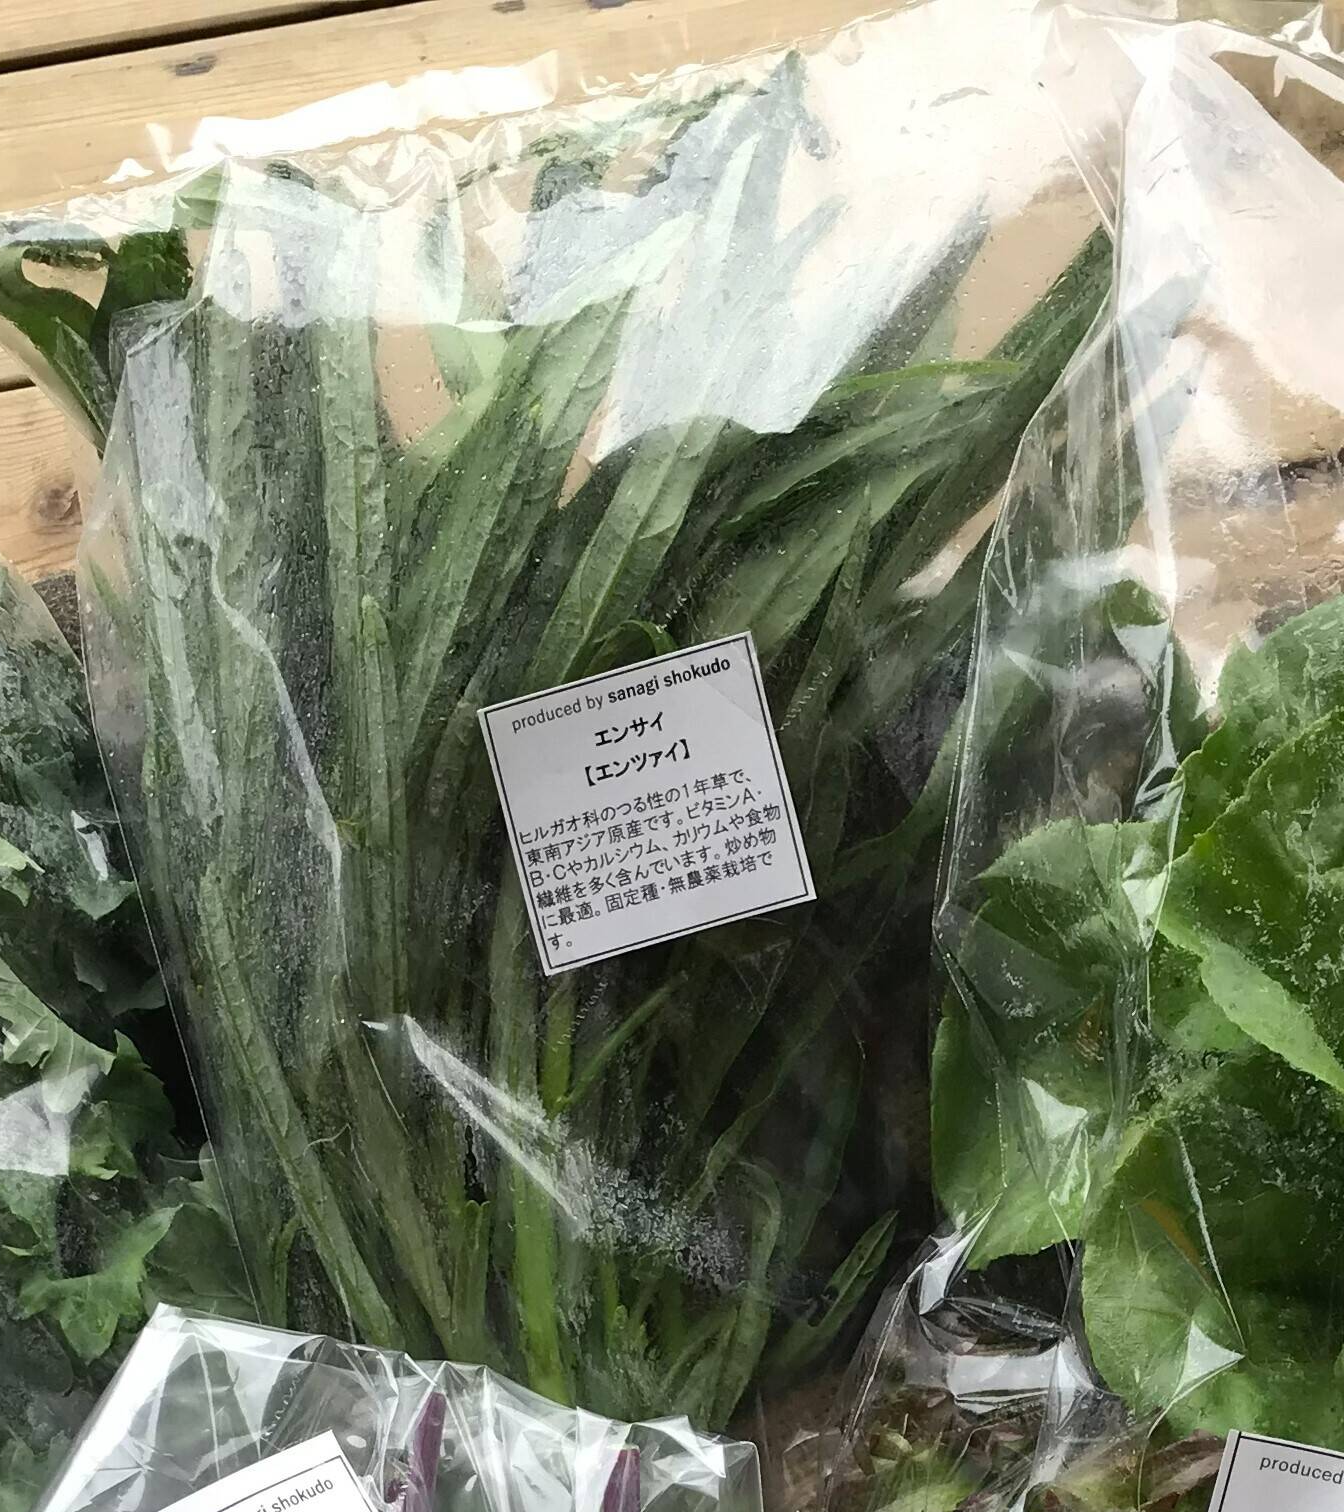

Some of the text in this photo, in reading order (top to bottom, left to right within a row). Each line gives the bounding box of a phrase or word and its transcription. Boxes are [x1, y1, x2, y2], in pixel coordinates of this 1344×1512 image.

[511, 656, 731, 734] produced by sanagi shokudo
[593, 710, 663, 747] エンサイ
[584, 737, 690, 787] 【エンツァイ】
[545, 932, 572, 952] す。
[1258, 1456, 1344, 1485] produced
